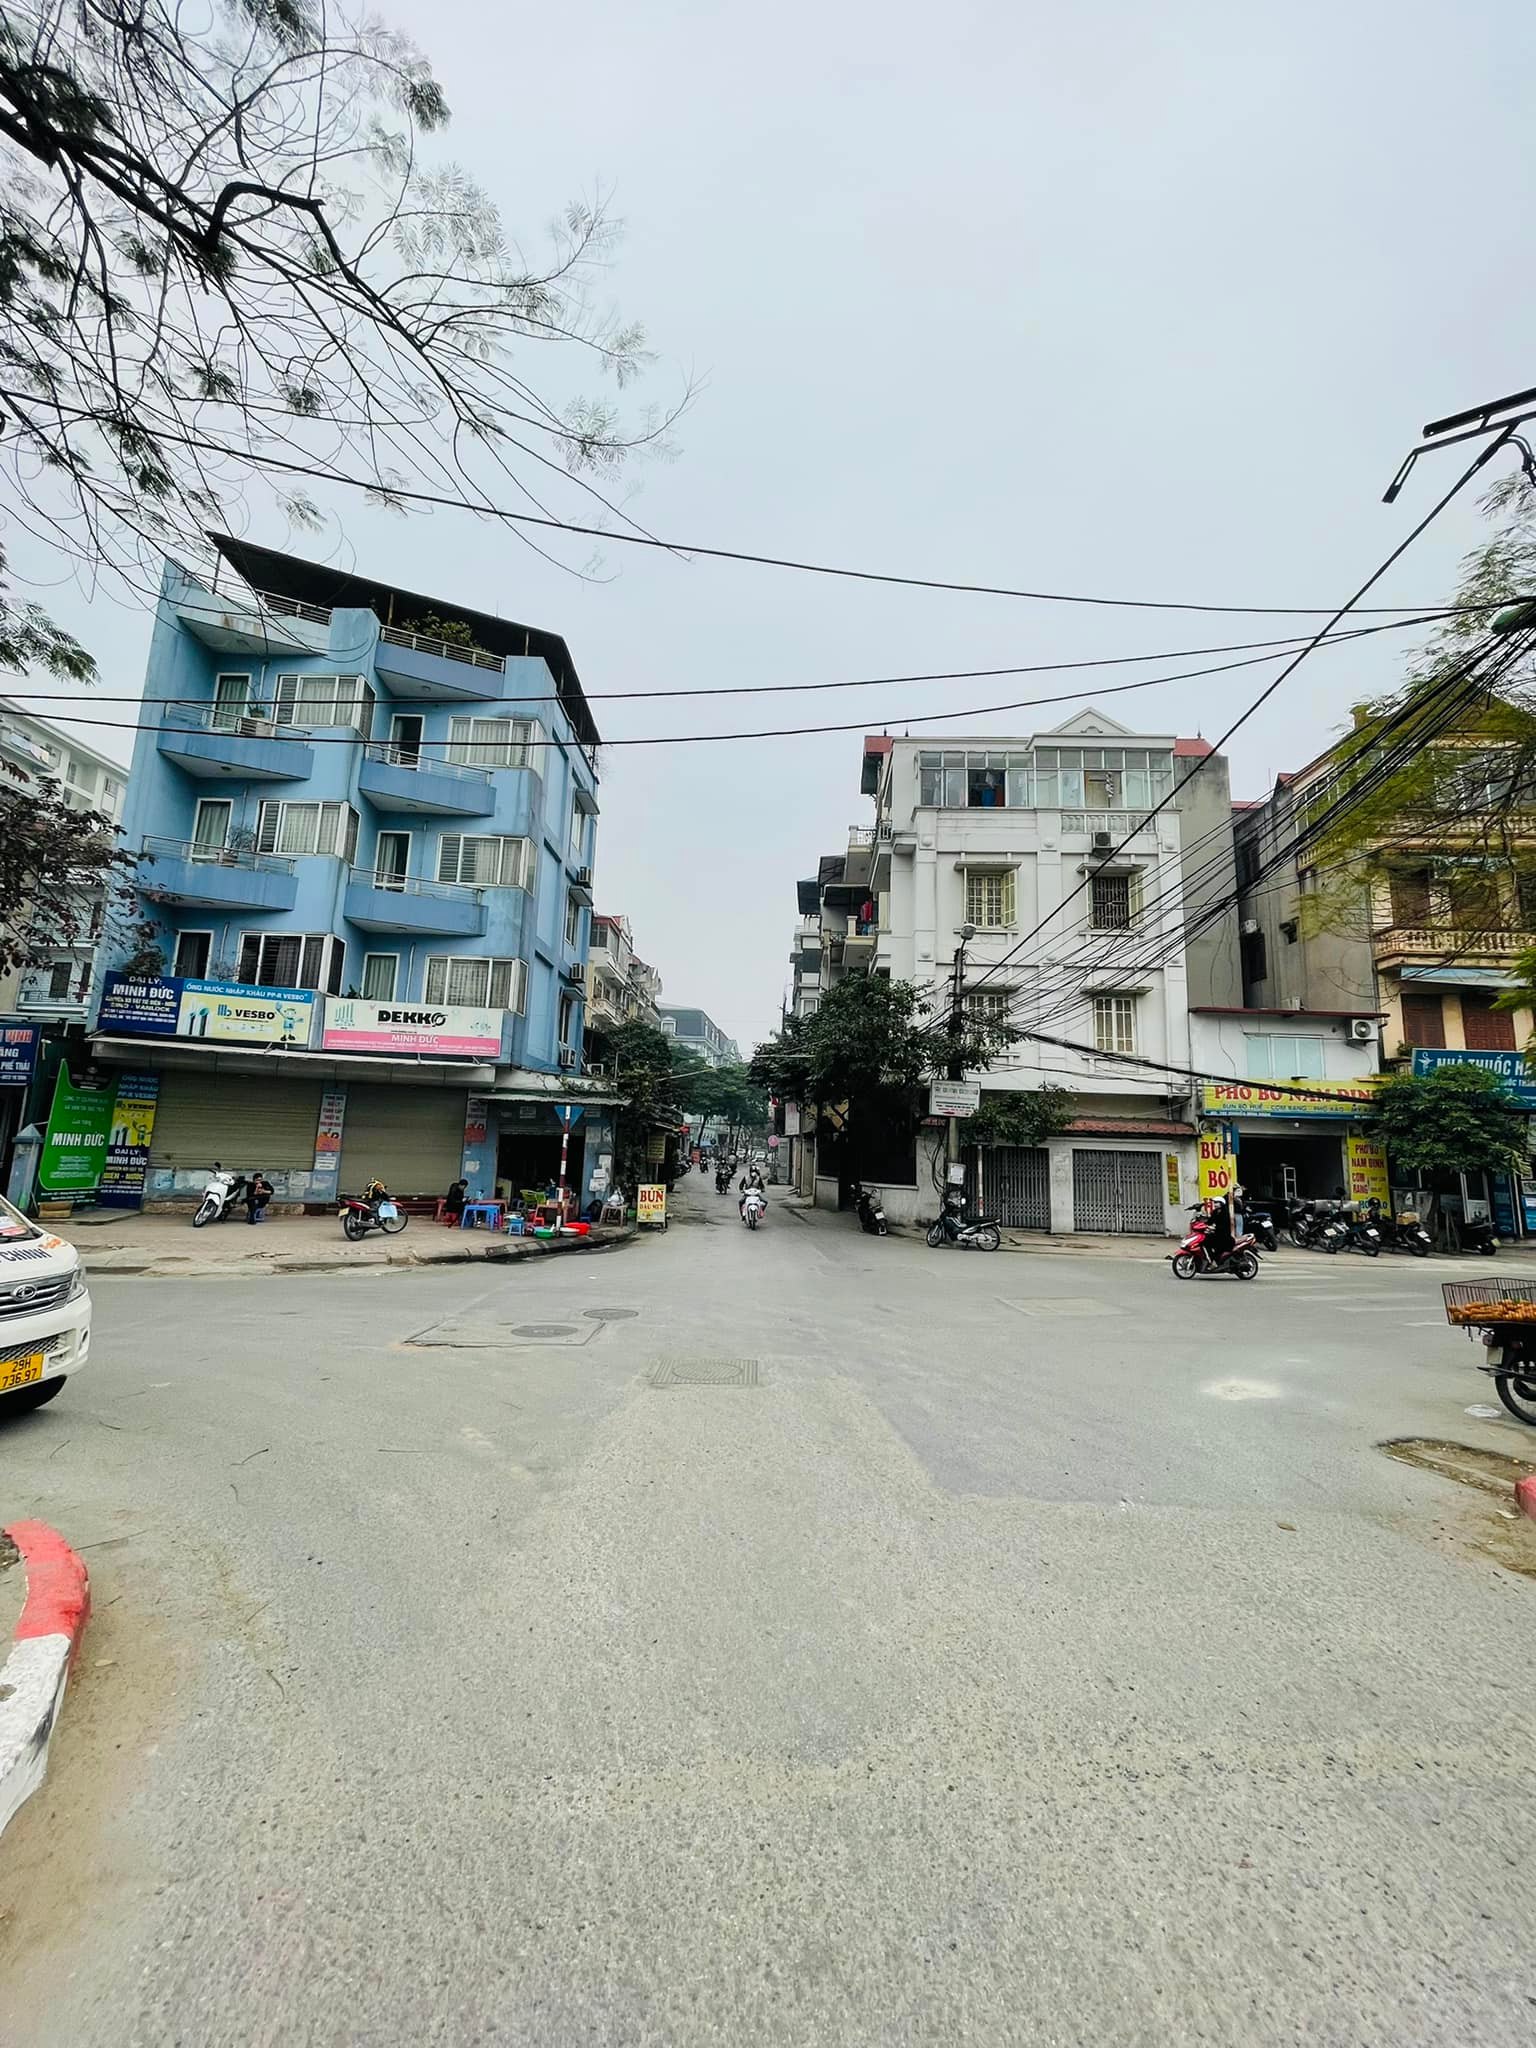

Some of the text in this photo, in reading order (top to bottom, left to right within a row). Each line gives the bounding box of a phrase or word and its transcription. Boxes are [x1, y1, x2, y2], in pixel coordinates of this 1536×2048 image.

[112, 984, 175, 1000] MINH ĐỨC
[235, 1008, 276, 1020] VESBO
[377, 1010, 448, 1028] DEKKO
[391, 1033, 440, 1045] MINH ĐỨC
[51, 1131, 105, 1147] MINH ĐỨC
[1200, 1137, 1227, 1160] BÚ
[105, 1155, 148, 1166] MINH ĐỨC
[1351, 1157, 1367, 1168] NAM
[1208, 1165, 1229, 1188] BÒ
[639, 1186, 664, 1202] BÚN
[12, 1357, 32, 1373] 29H
[2, 1367, 38, 1388] 736.97
